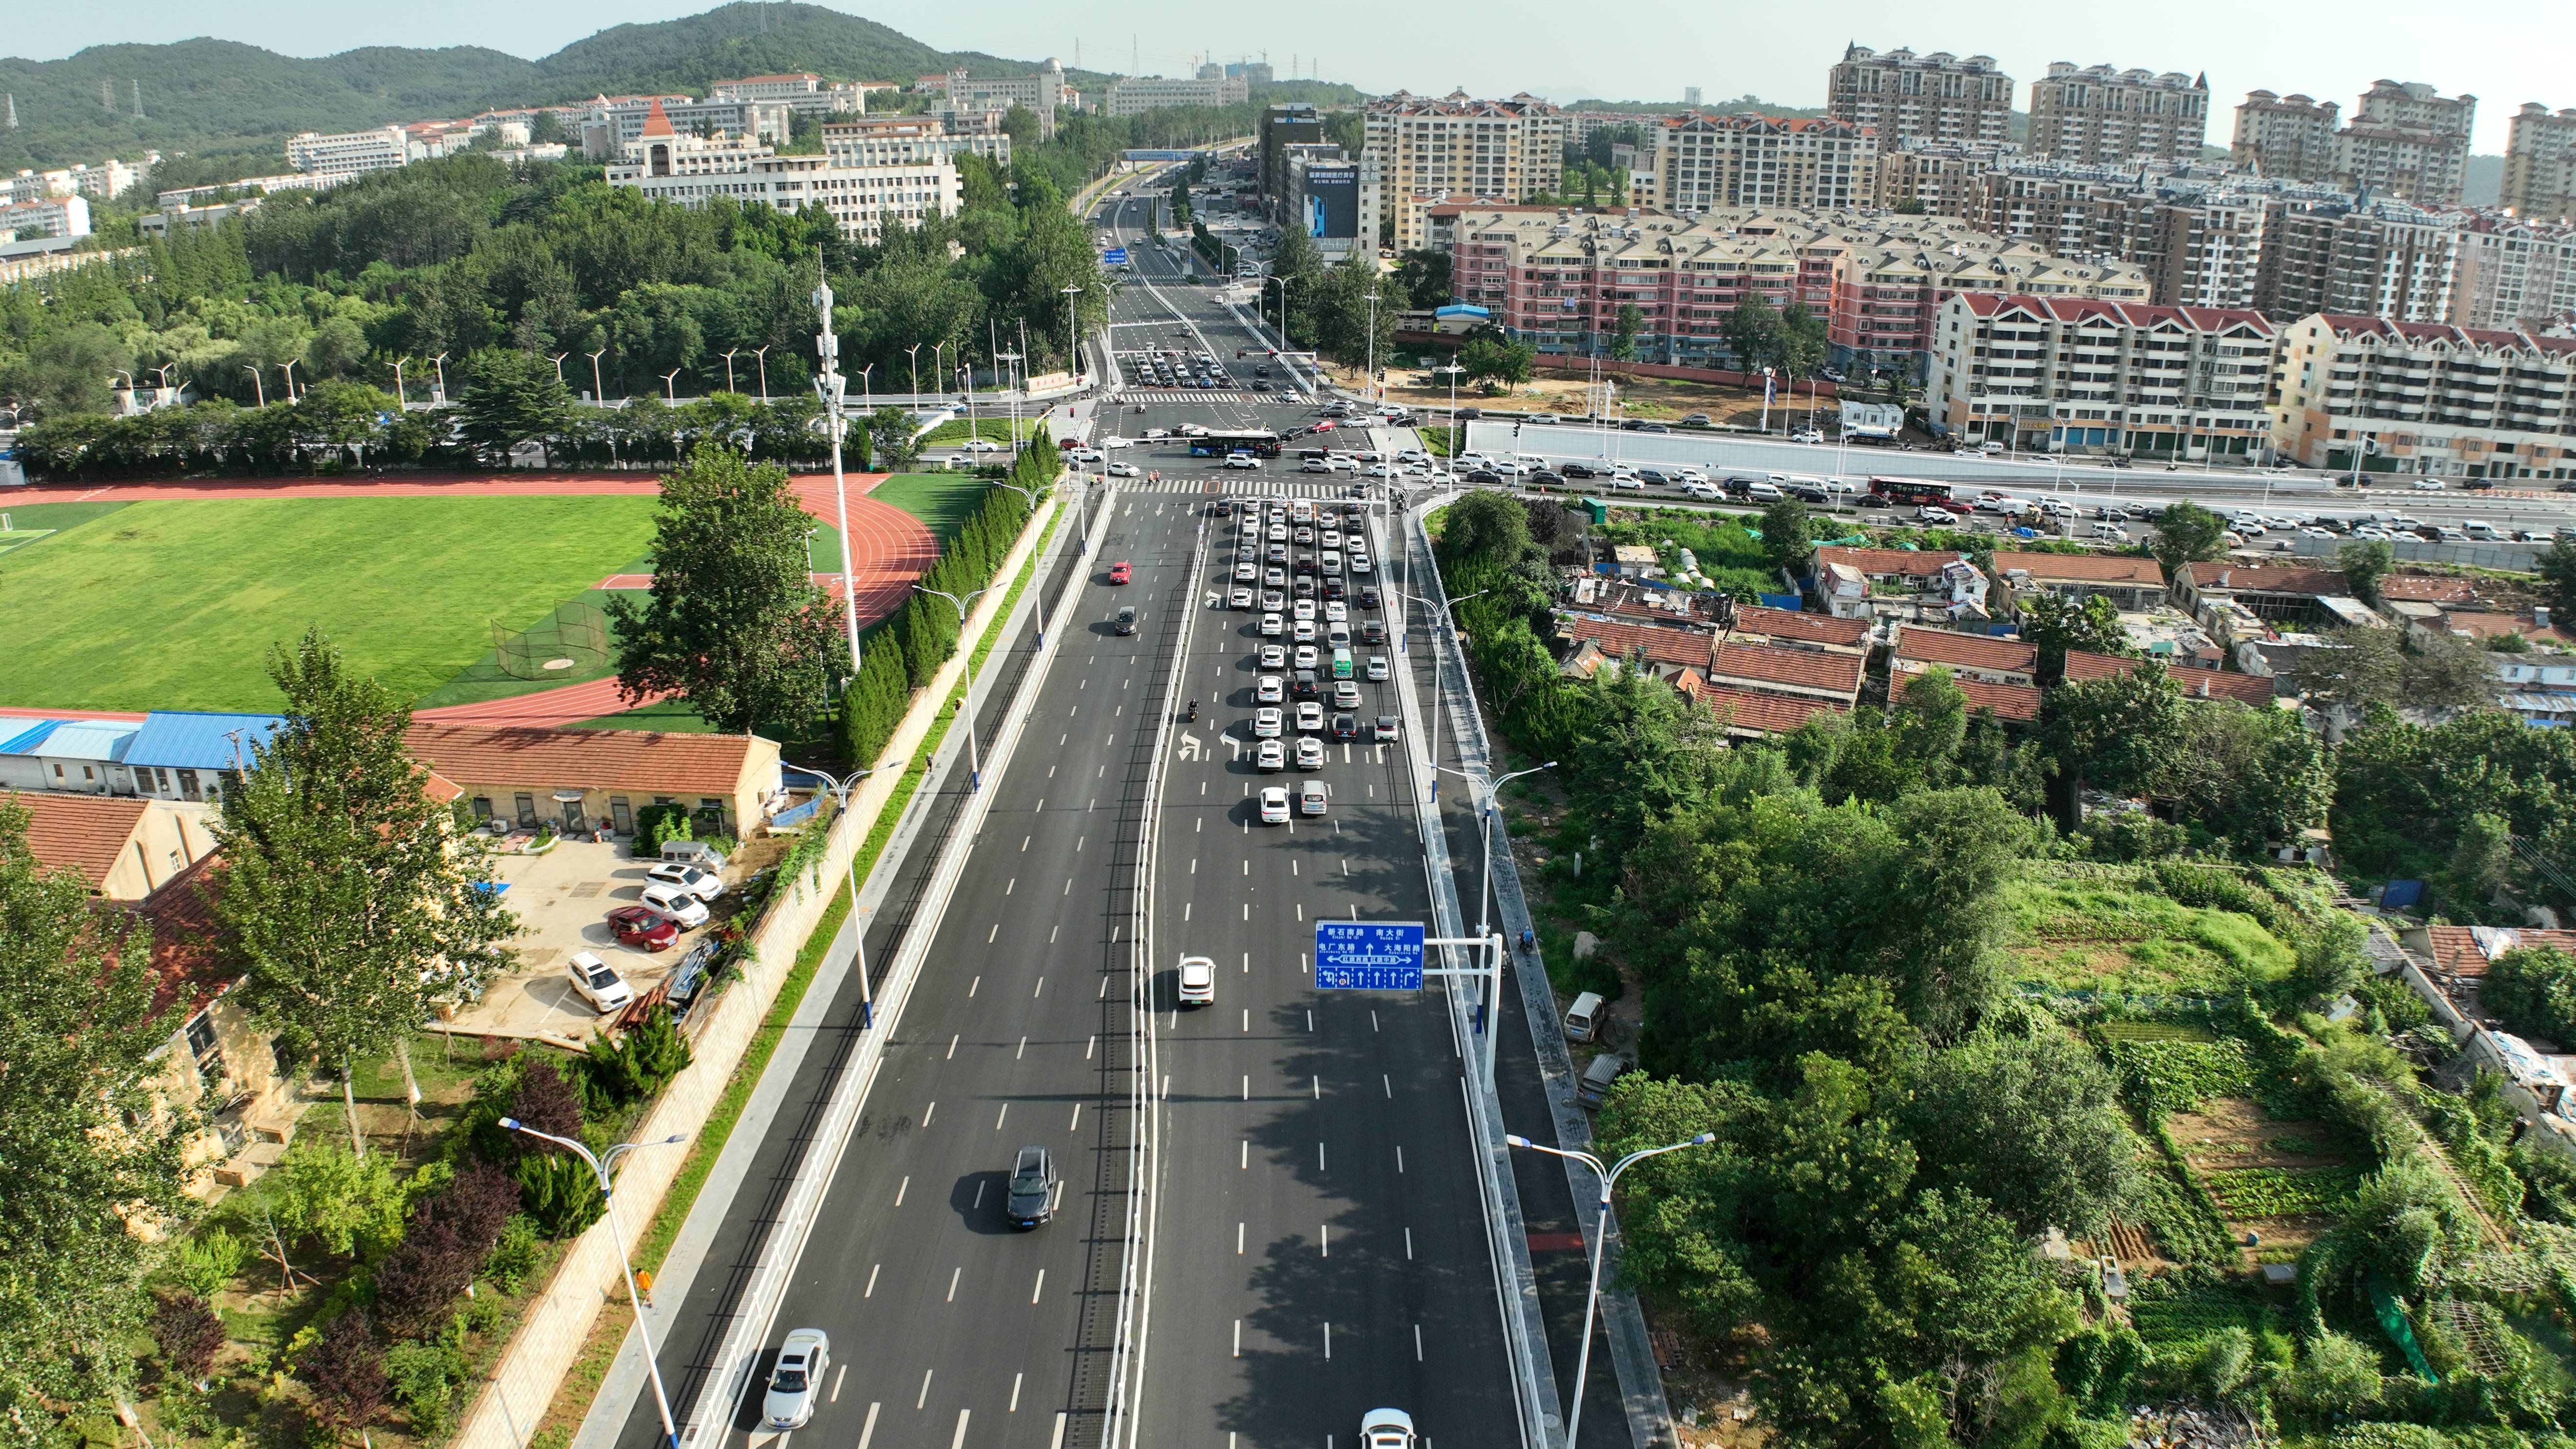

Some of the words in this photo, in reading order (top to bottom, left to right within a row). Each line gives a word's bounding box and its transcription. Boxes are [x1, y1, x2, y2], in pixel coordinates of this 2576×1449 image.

[1361, 172, 1380, 180] 医院
[1328, 928, 1364, 936] 新石南路
[1376, 928, 1404, 937] 南大街
[1319, 943, 1355, 951] 电厂东路
[1385, 944, 1420, 952] 大海阳路
